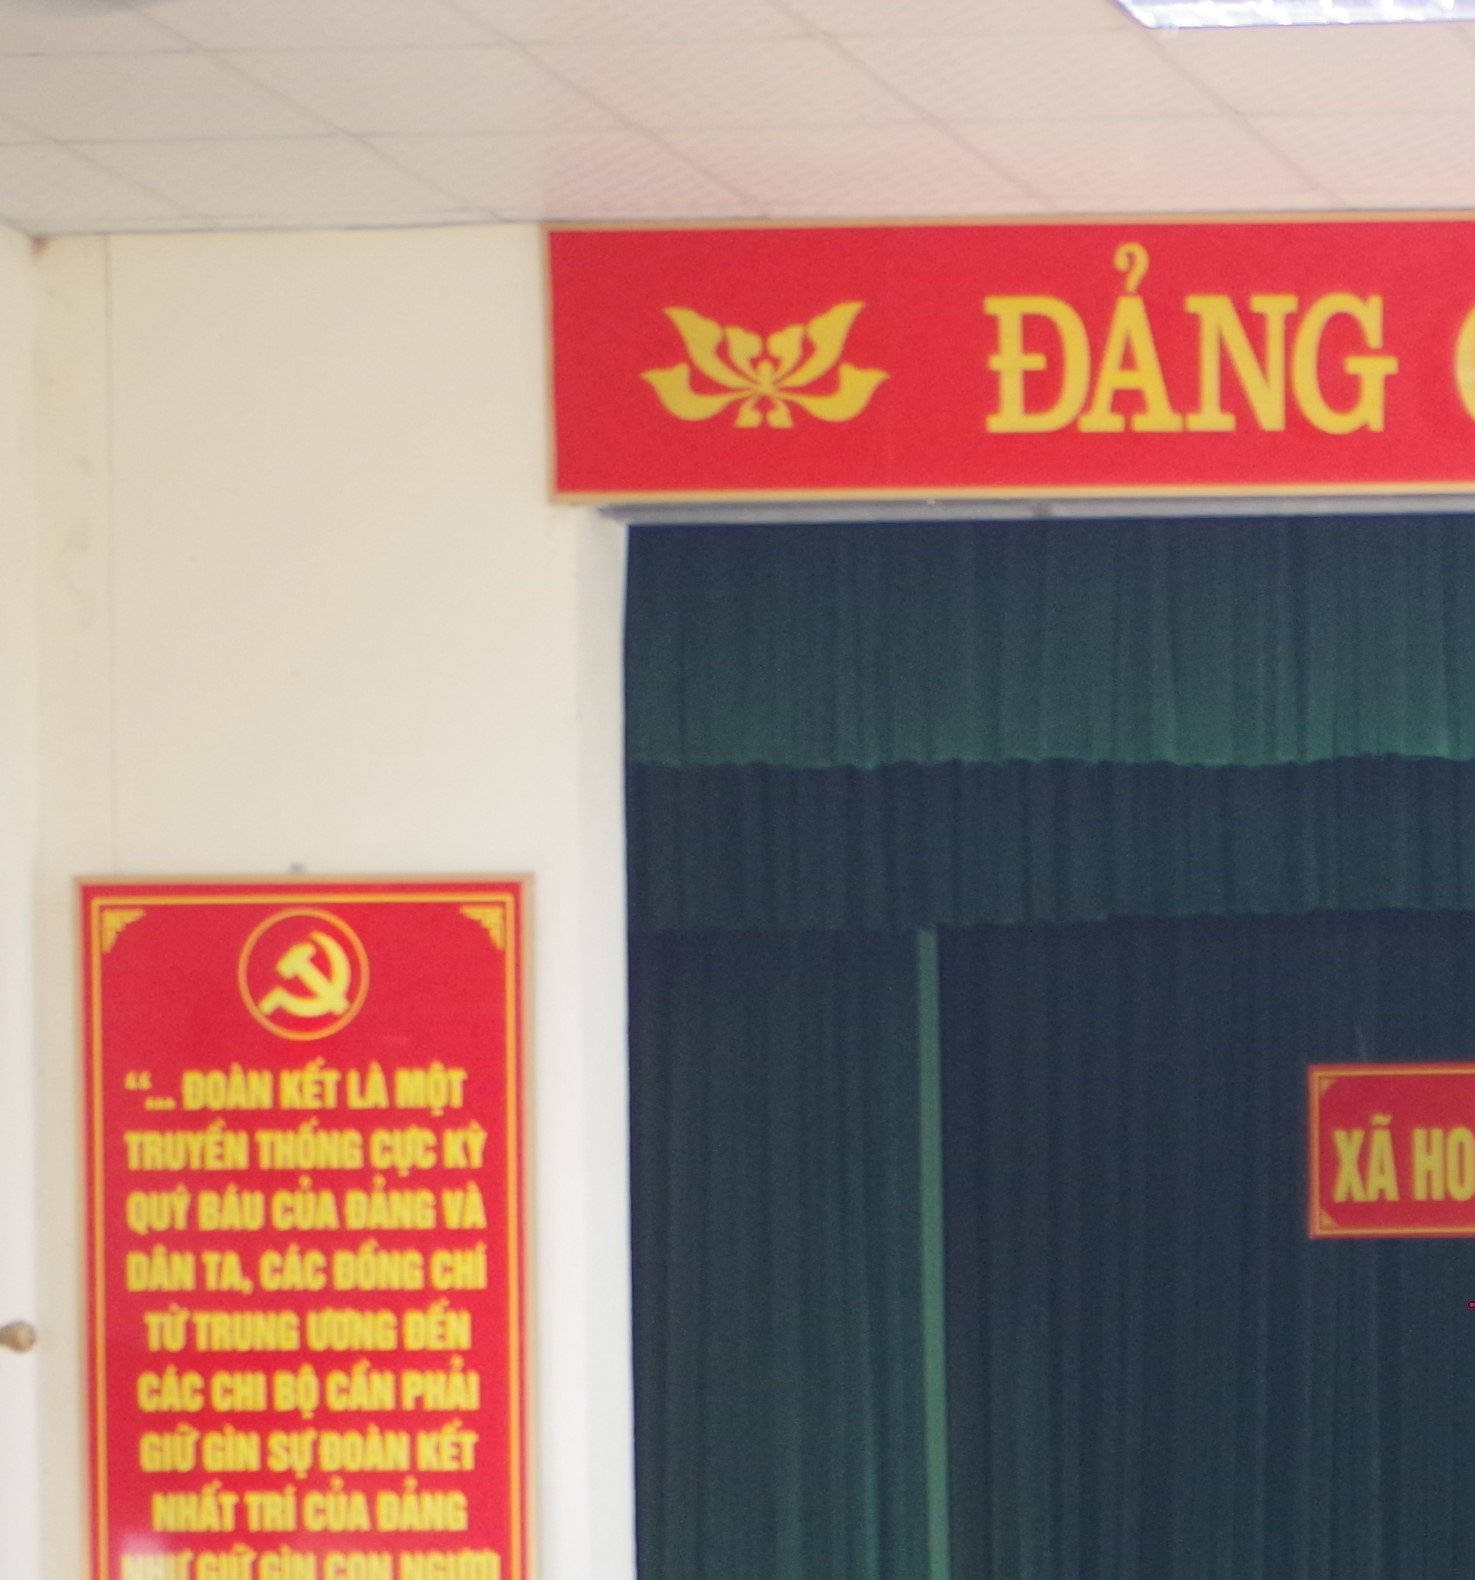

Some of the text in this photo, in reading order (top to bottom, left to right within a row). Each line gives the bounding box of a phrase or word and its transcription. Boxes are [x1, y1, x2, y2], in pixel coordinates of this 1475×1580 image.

[984, 242, 1398, 435] ĐẢNG
[279, 1056, 341, 1110] KẾT
[347, 1060, 390, 1109] LÀ
[395, 1060, 467, 1117] MỘT
[255, 1116, 364, 1170] THỐNG
[370, 1124, 437, 1177] CỰC
[1332, 1113, 1399, 1202] XÃ
[271, 1174, 339, 1231] CỦA
[344, 1172, 437, 1230] ĐẢNG
[441, 1180, 488, 1230] VÀ
[126, 1243, 196, 1292] DÂN
[201, 1250, 254, 1295] TA,
[259, 1242, 327, 1291] CÁC
[430, 1241, 488, 1290] CHÍ
[192, 1310, 300, 1352] TRUNG
[403, 1296, 472, 1350] ĐẾN
[137, 1363, 205, 1412] CÁC
[210, 1369, 267, 1412] CHI
[273, 1362, 320, 1420] BỘ
[402, 1354, 480, 1411] PHẢI
[202, 1423, 261, 1472] GÌN
[266, 1426, 318, 1480] SỰ
[417, 1417, 479, 1472] KẾT
[152, 1475, 469, 1533] NHẤT TRÍ CỦA ĐẢNG
